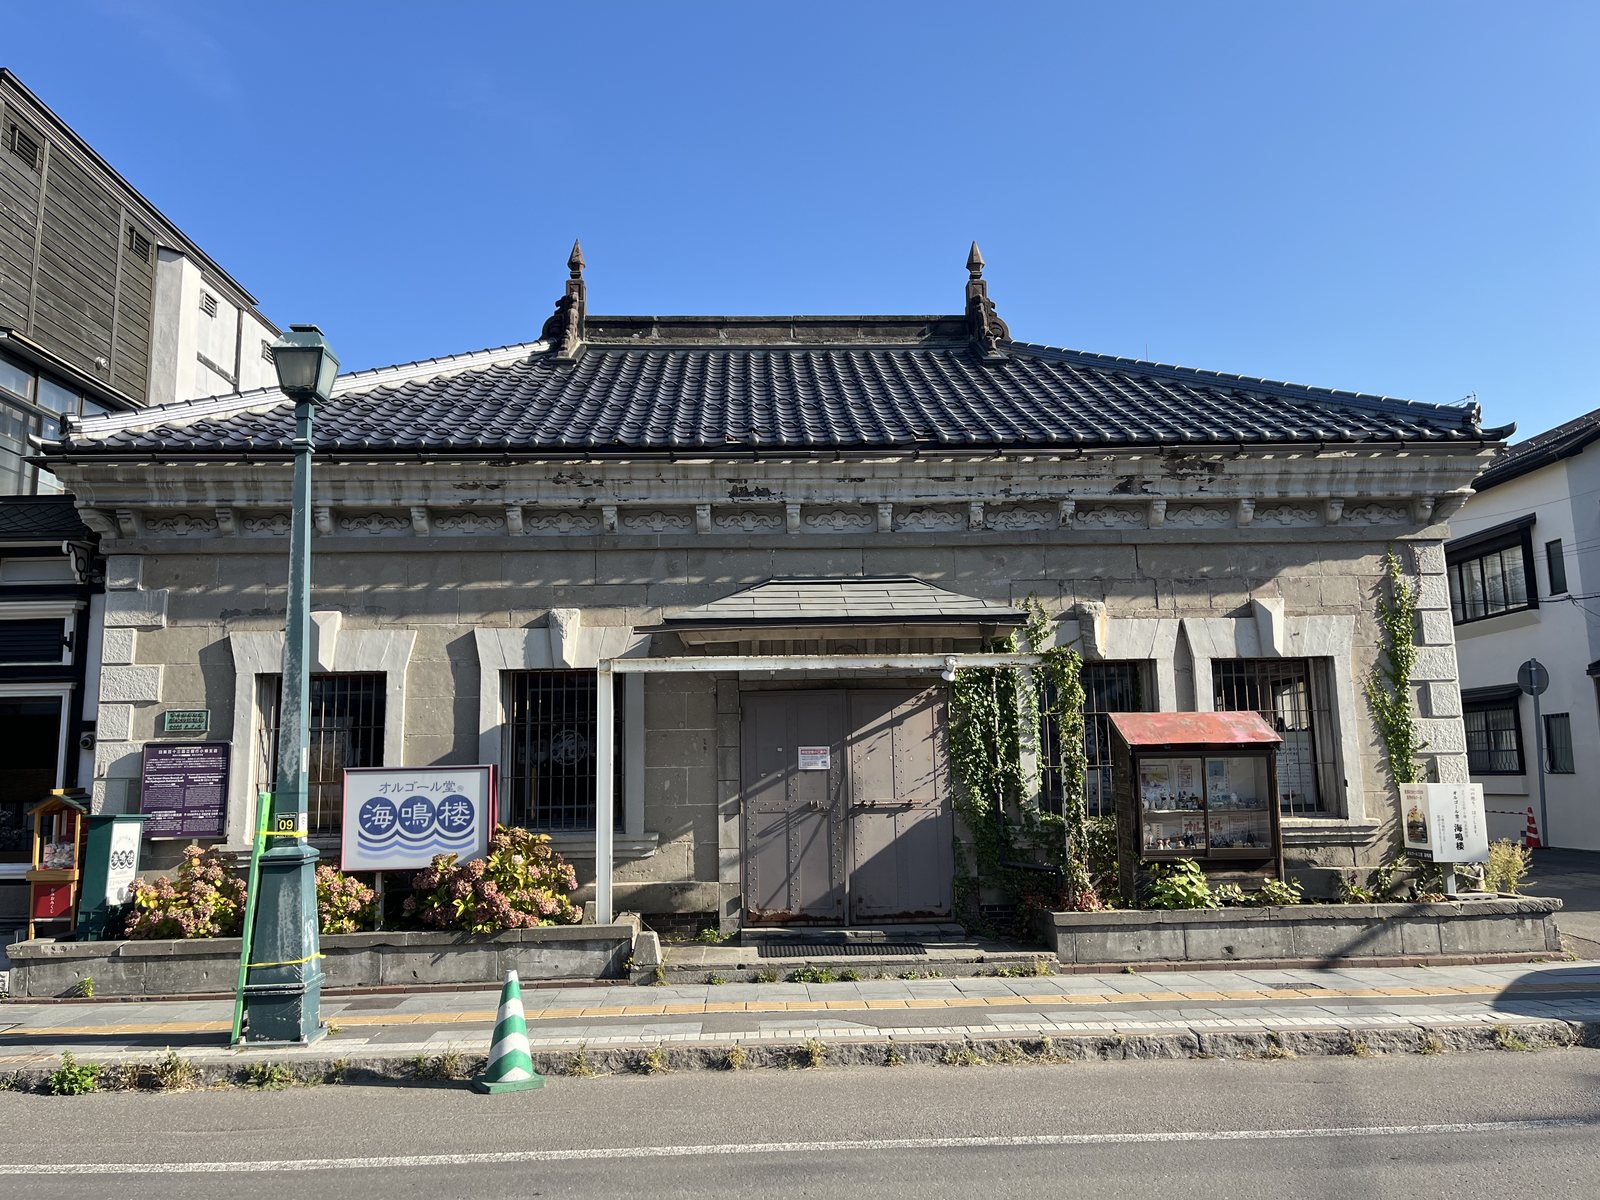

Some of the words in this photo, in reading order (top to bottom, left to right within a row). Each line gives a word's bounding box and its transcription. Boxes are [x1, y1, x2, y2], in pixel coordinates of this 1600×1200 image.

[279, 819, 294, 831] 09
[362, 801, 472, 829] 海鳴楼
